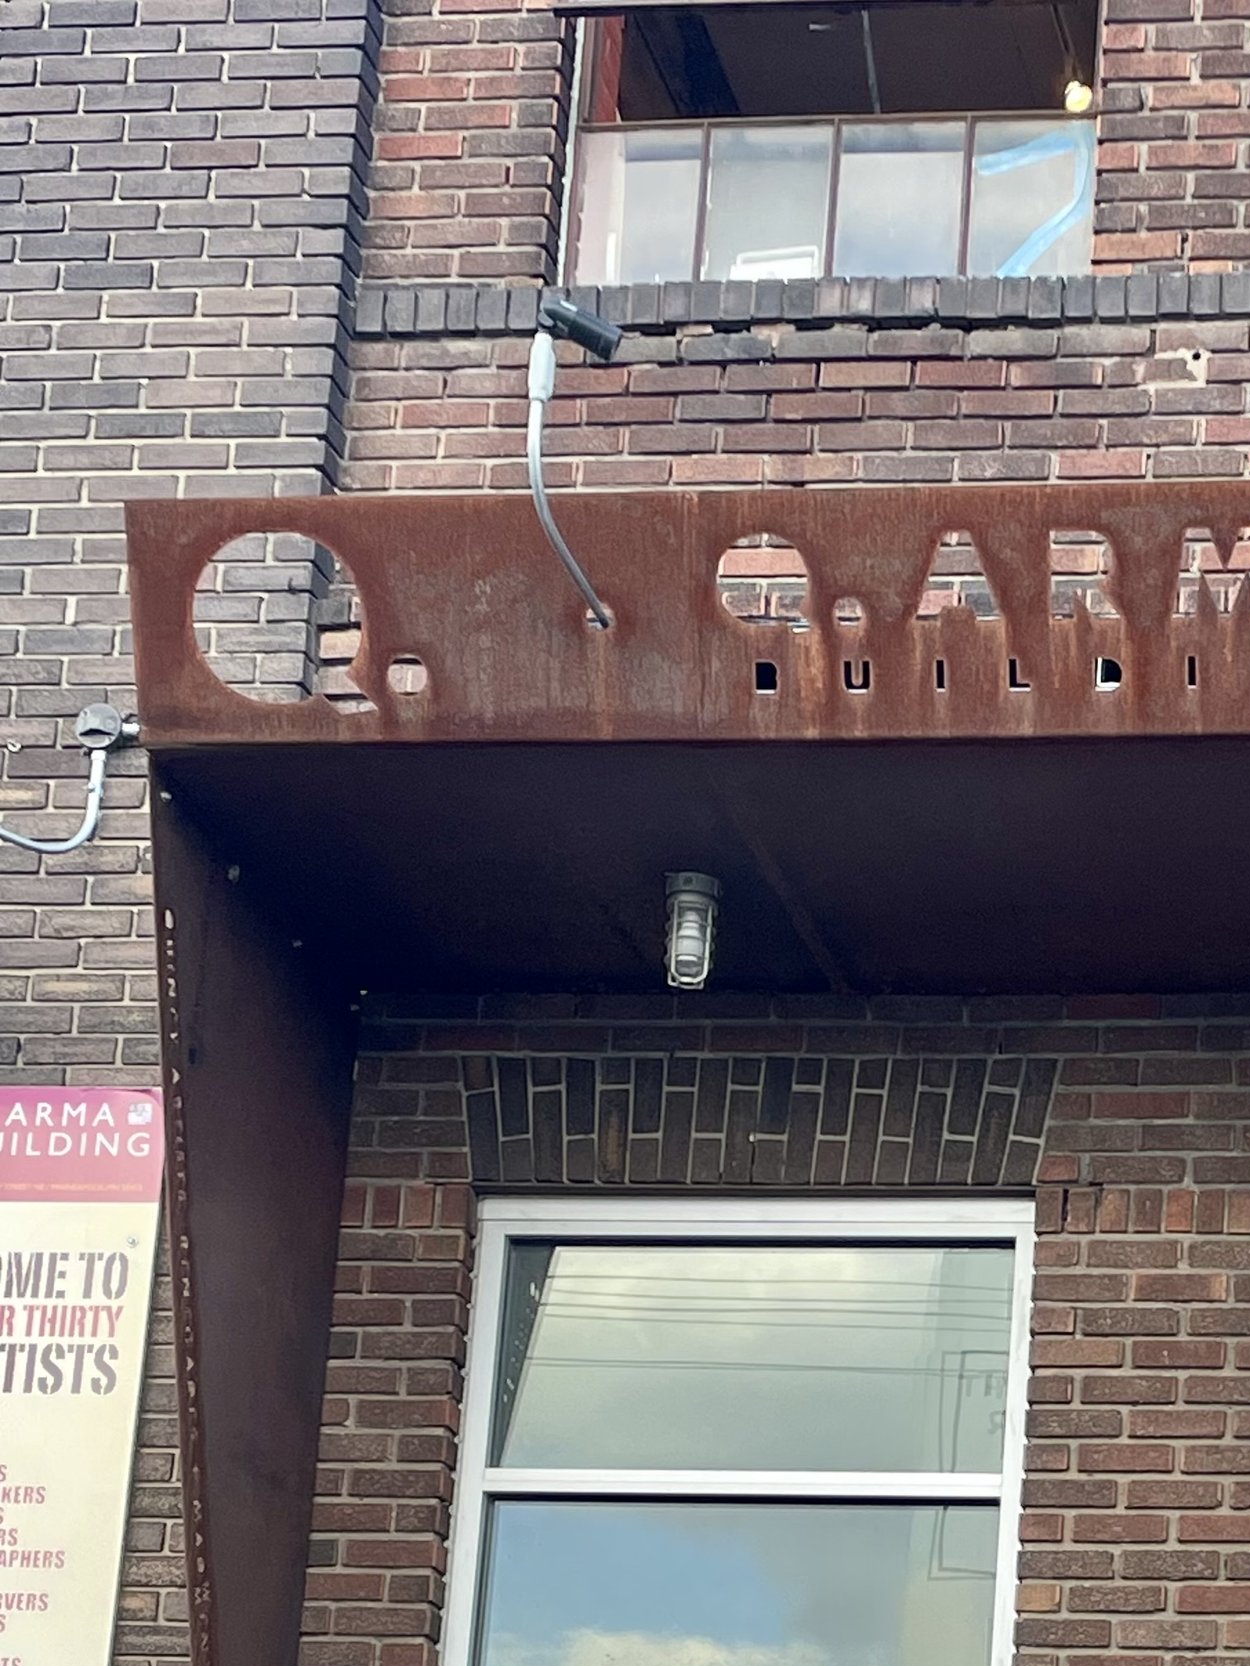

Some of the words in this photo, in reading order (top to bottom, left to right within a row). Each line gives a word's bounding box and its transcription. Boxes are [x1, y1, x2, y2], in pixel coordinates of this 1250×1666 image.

[3, 1101, 116, 1127] ARMA
[0, 1251, 70, 1299] ME
[78, 1251, 129, 1300] TO
[23, 1304, 124, 1338] THIRTY
[0, 1343, 119, 1395] TISTS
